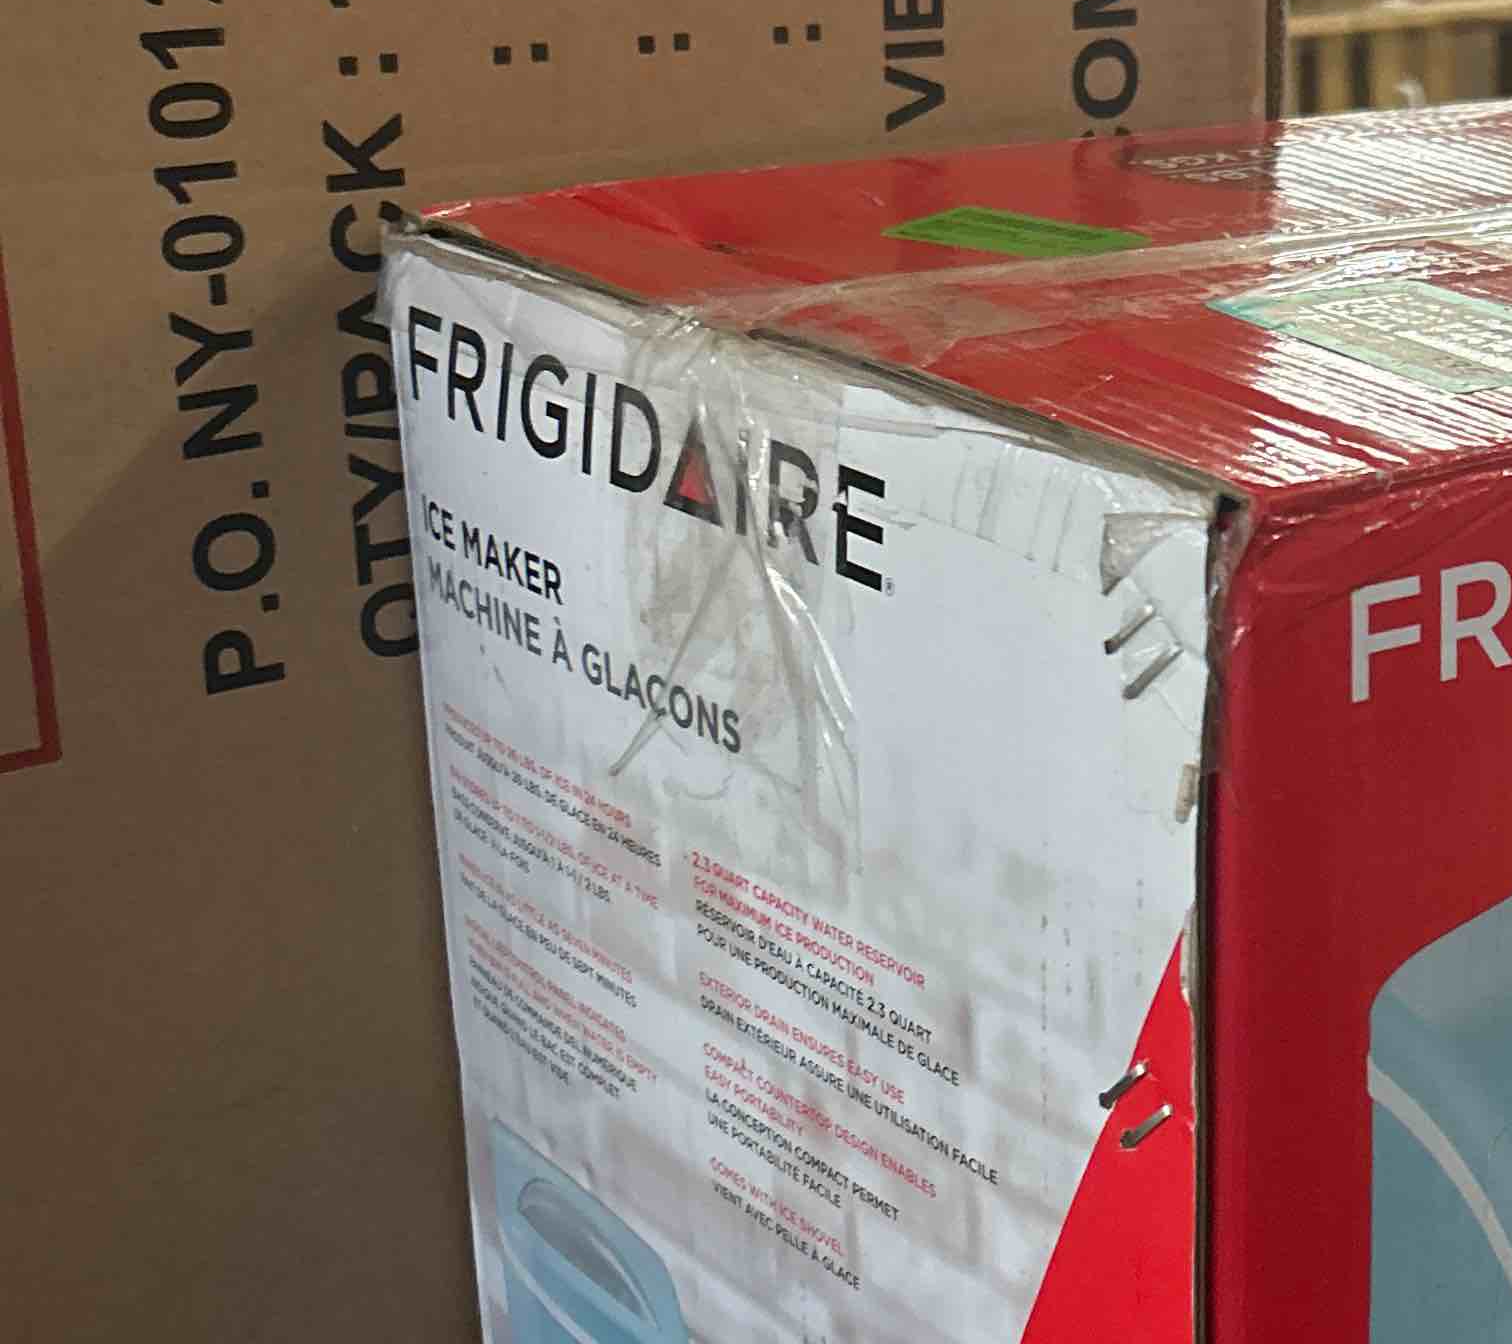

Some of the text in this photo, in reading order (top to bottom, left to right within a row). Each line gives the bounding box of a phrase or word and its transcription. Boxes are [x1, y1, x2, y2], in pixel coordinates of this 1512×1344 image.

[408, 305, 886, 593] FRIGIDAIRE
[422, 493, 564, 607] ICE MAKER
[427, 556, 543, 657] MACHINE
[551, 615, 573, 673] À
[752, 884, 809, 925] CAPACITY
[812, 914, 855, 950] WATER
[855, 938, 926, 992] RESERVOIR
[774, 918, 794, 944] ICE
[795, 930, 876, 988] PRODUCTION
[697, 922, 961, 1089] POUR UNE PRODUCTION MAXIMALE DE GLACE
[888, 1009, 933, 1047] QUART
[700, 993, 736, 1027] DRAIN
[799, 1055, 847, 1097] ASSURE
[846, 1082, 873, 1112] UNE
[873, 1097, 951, 1162] UTILISATION
[951, 1146, 1001, 1188] FACILE
[846, 1057, 880, 1088] EASY
[880, 1078, 906, 1106] USE
[720, 1097, 794, 1156] CONCEPTION
[793, 1144, 851, 1192] COMPACT
[851, 1180, 900, 1223] PERMET
[801, 1173, 843, 1211] FACILE
[880, 1151, 938, 1200] ENABLES
[774, 1222, 809, 1256] PELLE
[819, 1253, 862, 1292] GLACE
